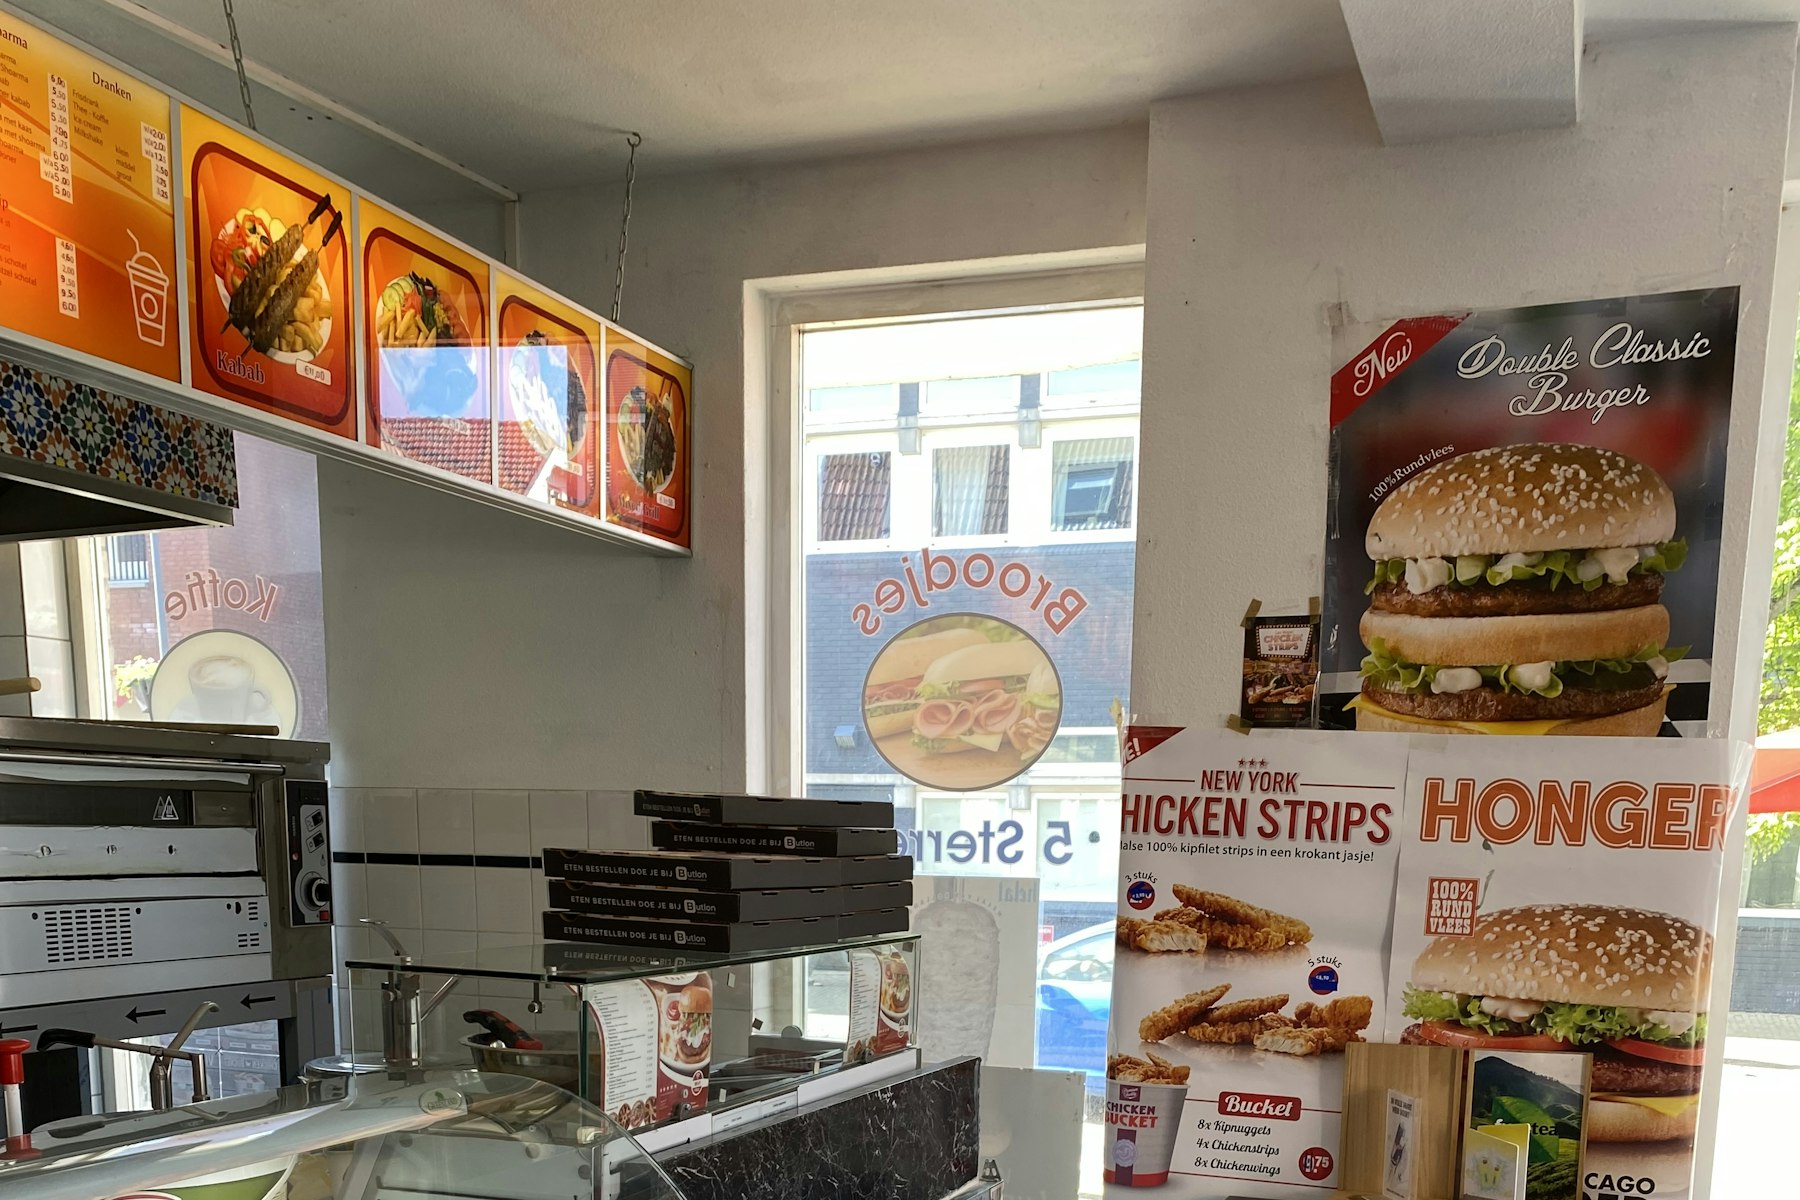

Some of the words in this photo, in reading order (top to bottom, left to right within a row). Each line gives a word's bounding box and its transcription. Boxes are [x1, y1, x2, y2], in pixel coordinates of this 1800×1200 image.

[92, 71, 132, 101] Dranken
[1455, 334, 1579, 379] Double
[1590, 322, 1712, 368] Classic
[215, 349, 266, 385] Kabab
[1354, 331, 1413, 396] New
[1508, 373, 1651, 425] Burger
[1200, 769, 1244, 791] NEW
[1247, 771, 1299, 793] YORK
[1121, 794, 1247, 837] HICKEN
[1257, 799, 1393, 844] STRIPS
[1420, 777, 1738, 851] HONGER
[673, 834, 693, 842] ETEN
[695, 836, 738, 845] BESTELLEN
[740, 838, 756, 846] DOE
[1120, 841, 1143, 851] alse
[1147, 841, 1178, 853] 100%
[1180, 843, 1220, 856] kipfilet
[1222, 846, 1254, 858] strips
[1256, 846, 1267, 857] in
[1270, 849, 1292, 858] een
[1294, 848, 1341, 860] krokant
[1342, 851, 1374, 863] jasje!
[564, 863, 583, 872] ETEN
[585, 864, 629, 875] BESTELLEN
[630, 867, 648, 876] DOE
[650, 869, 659, 877] JE
[660, 869, 673, 878] BIJ
[1125, 874, 1132, 884] 3
[1133, 871, 1158, 884] stuks
[1432, 880, 1474, 900] 100%
[571, 895, 590, 904] ETEN
[592, 897, 636, 907] BESTELLEN
[638, 900, 655, 909] DOE
[657, 901, 666, 909] JE
[668, 902, 682, 910] BIJ
[1430, 899, 1473, 918] RUND
[563, 926, 583, 935] ETEN
[584, 928, 628, 938] BESTELLEN
[629, 931, 647, 939] DOE
[648, 932, 657, 940] JE
[659, 933, 672, 941] BIJ
[1430, 917, 1471, 934] VLEES
[1308, 958, 1315, 967] 5
[1316, 955, 1343, 969] stuks
[1106, 1101, 1156, 1116] CHICKEN
[1225, 1094, 1293, 1117] Bucket
[1197, 1119, 1212, 1130] 8x
[1213, 1120, 1271, 1137] Kipnuggets
[1196, 1138, 1209, 1149] 4x
[1211, 1139, 1280, 1157] Chickenstrips
[1194, 1156, 1209, 1168] 8x
[1210, 1158, 1281, 1177] Chickenwings
[1584, 1172, 1656, 1194] CAGO
